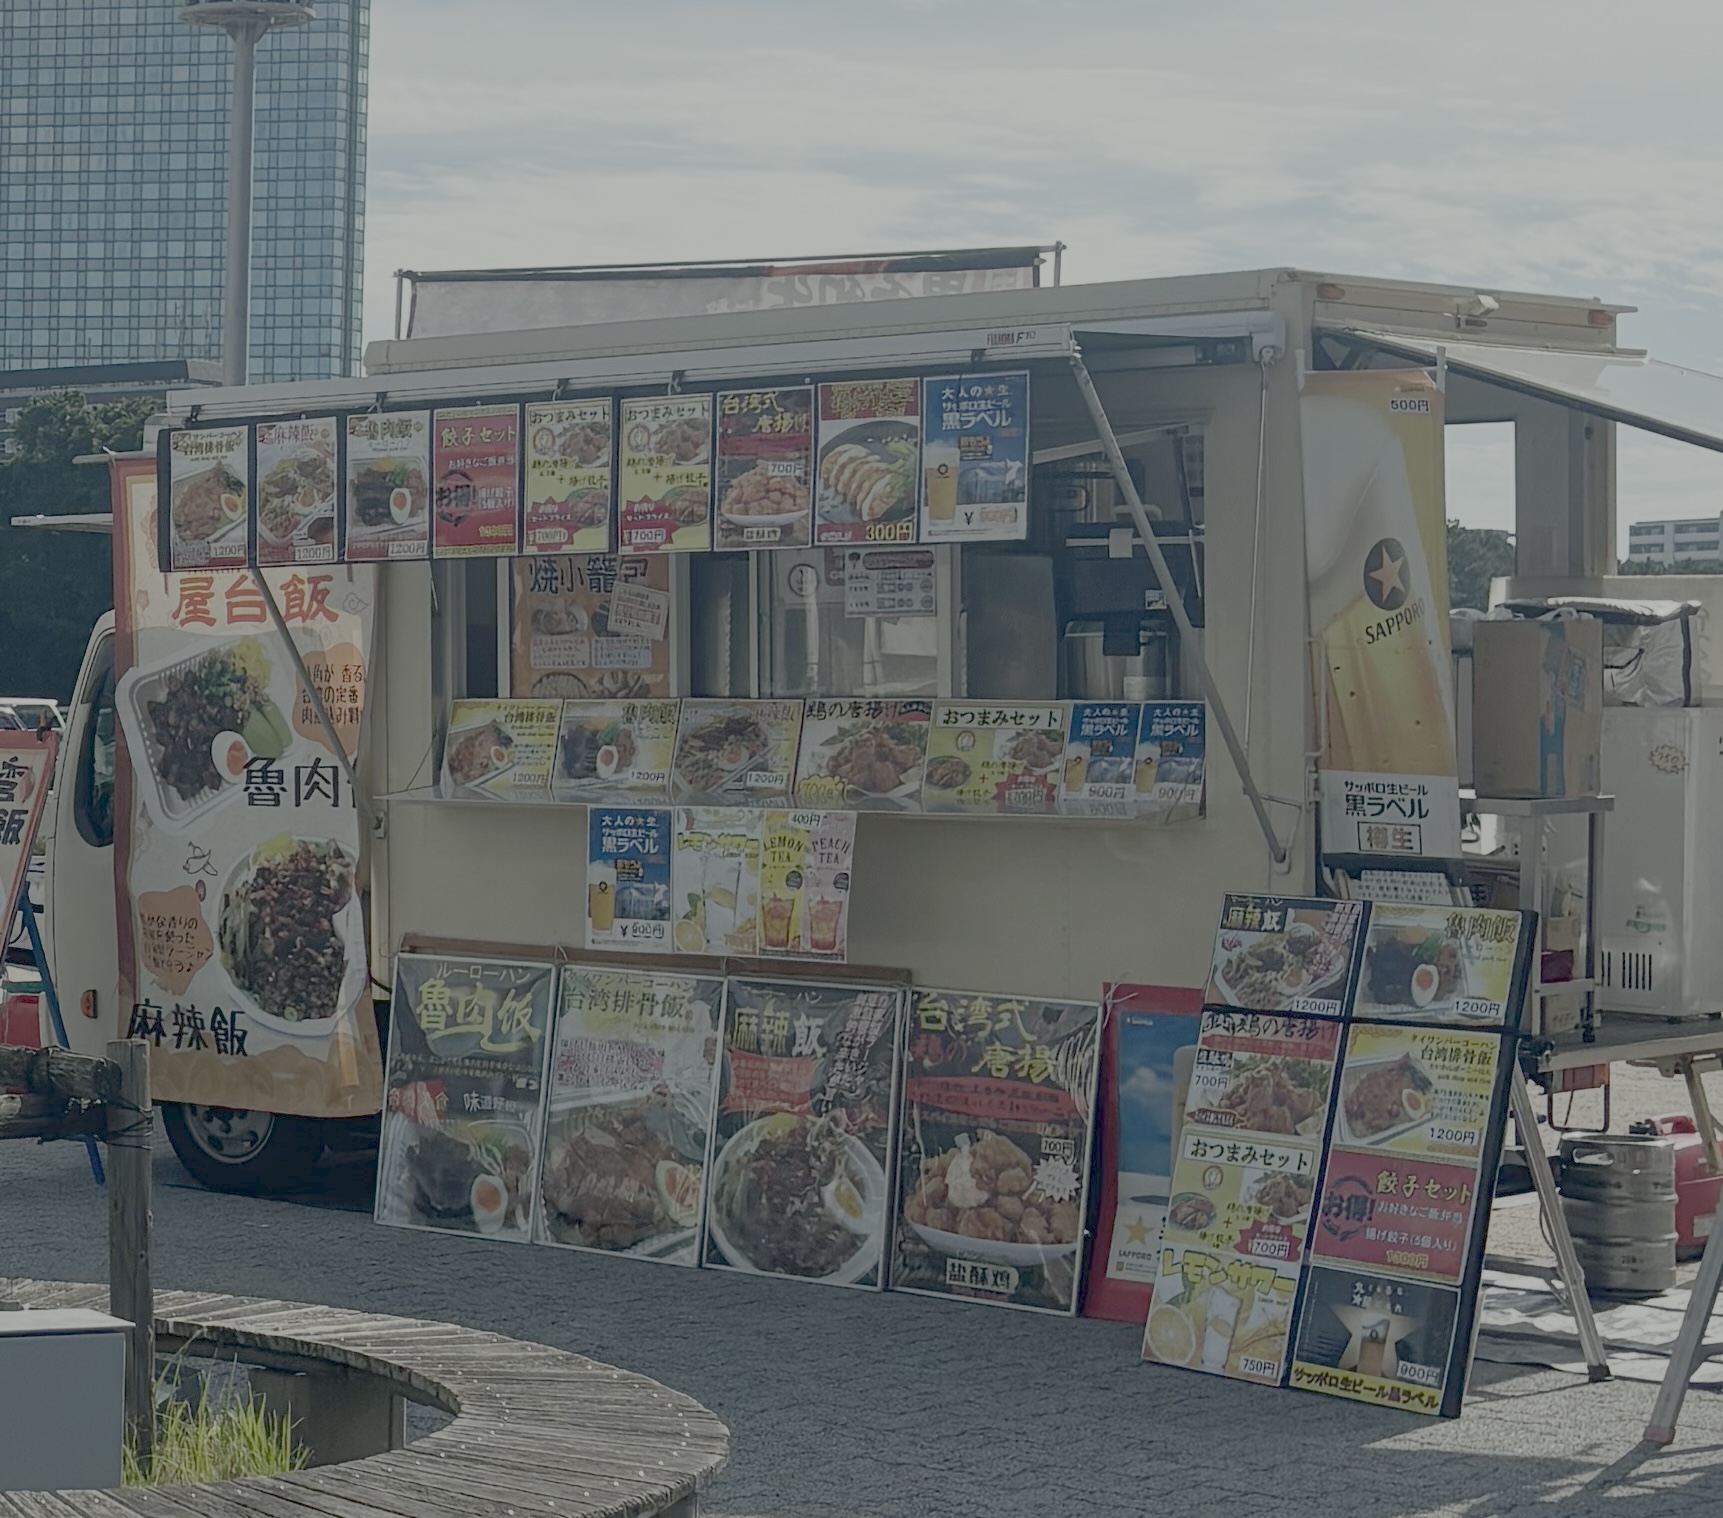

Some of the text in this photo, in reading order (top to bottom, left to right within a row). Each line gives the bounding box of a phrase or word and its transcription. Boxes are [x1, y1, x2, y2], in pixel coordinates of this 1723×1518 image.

[627, 403, 709, 421] おつまみセット
[1391, 399, 1430, 412] 500円
[530, 405, 609, 425] おつまみセット
[942, 409, 1012, 431] 黒ラベル
[440, 425, 515, 448] 餃子セット
[633, 531, 664, 543] 700円
[865, 524, 911, 542] 300円
[298, 546, 331, 560] 1200円
[391, 543, 425, 557] 1200円
[173, 574, 338, 627] 屋台飯
[1365, 600, 1425, 645] SAPPORO
[943, 708, 1059, 729] おつまみセット
[243, 756, 357, 808] 魯肉
[630, 770, 666, 783] 1200円
[748, 772, 785, 787] 1200円
[1344, 781, 1429, 798] サッポロ生ビール
[1345, 794, 1430, 819] 黒ラベル
[602, 837, 660, 854] 黒ラベル
[763, 836, 804, 852] LEMON
[812, 838, 851, 854] PEACH
[771, 851, 792, 863] TEA
[819, 852, 840, 865] TEA
[437, 962, 532, 984] ルーローハン
[565, 987, 686, 1019] 台湾排骨飯
[1295, 1000, 1338, 1014] 1200円
[1455, 1001, 1502, 1016] 1200円
[128, 997, 249, 1056] 麻辣飯
[918, 996, 1037, 1041] 台湾式
[1194, 1075, 1229, 1090] 700円
[1429, 1128, 1476, 1145] 1200円
[1190, 1139, 1308, 1172] おつまみセット
[1376, 1170, 1473, 1205] 餃子セット
[1254, 1241, 1288, 1258] 700円
[1242, 1358, 1277, 1377] 750円
